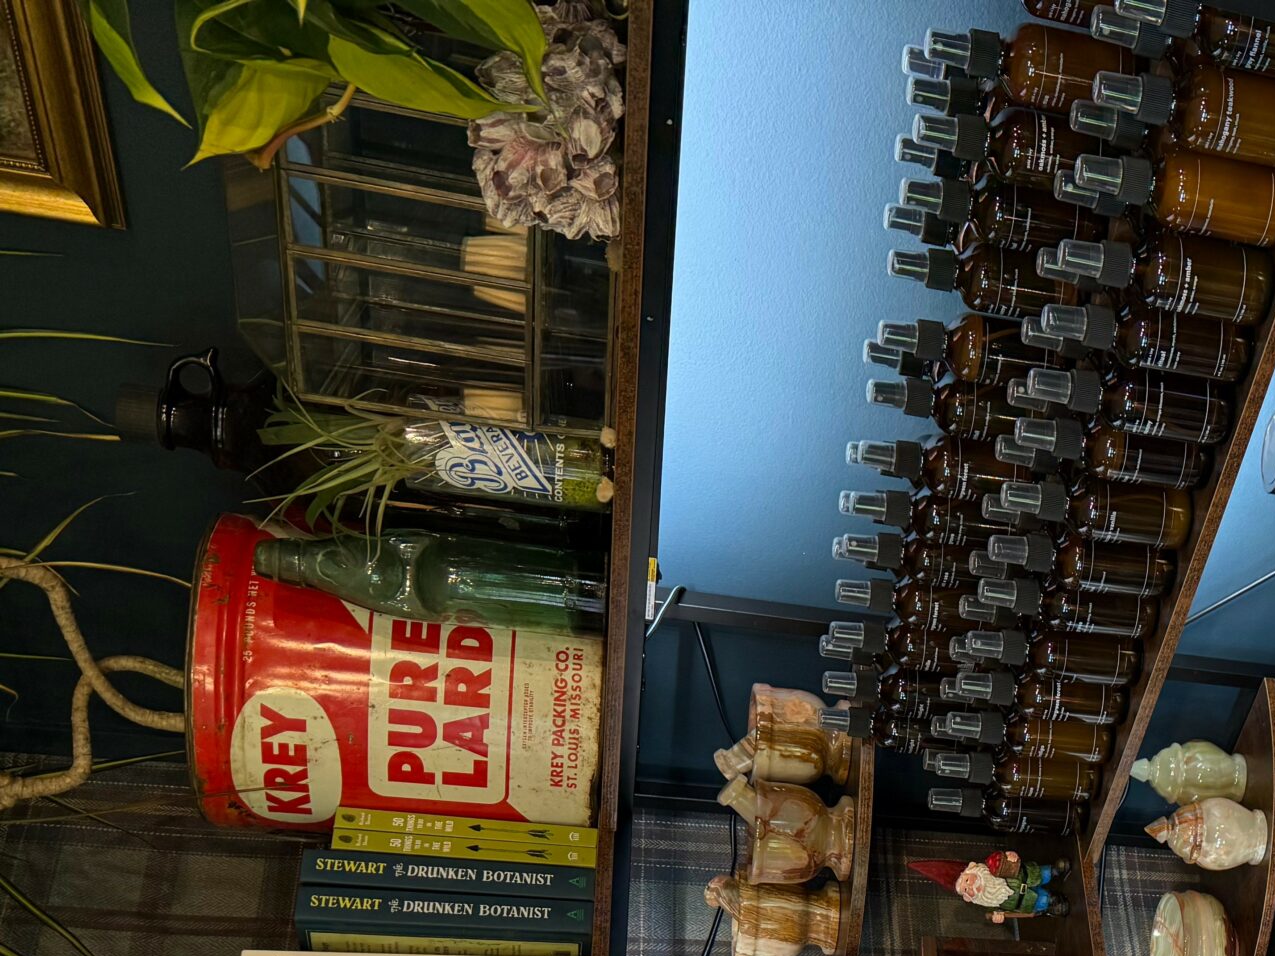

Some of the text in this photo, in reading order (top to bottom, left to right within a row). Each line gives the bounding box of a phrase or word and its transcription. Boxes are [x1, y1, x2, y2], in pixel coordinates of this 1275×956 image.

[1249, 29, 1263, 57] flannel
[1215, 77, 1235, 151] mahogany teakwood
[1183, 257, 1193, 279] amber
[554, 444, 564, 502] CONTENTS
[569, 647, 584, 721] MISSOURI
[387, 619, 441, 785] PURE
[442, 618, 493, 788] LARD
[550, 646, 570, 787] KREY PACKING CO.
[259, 703, 313, 815] KREY
[567, 772, 577, 789] ST.
[392, 817, 404, 827] 50
[405, 814, 415, 832] THINGS
[390, 838, 401, 848] 50
[315, 857, 386, 875] STEWART
[407, 865, 476, 881] DRUNKEN
[482, 870, 554, 886] BOTANIST
[310, 894, 381, 910] STEWART
[403, 899, 473, 916] DRUNKEN
[479, 904, 551, 919] BOTANIST
